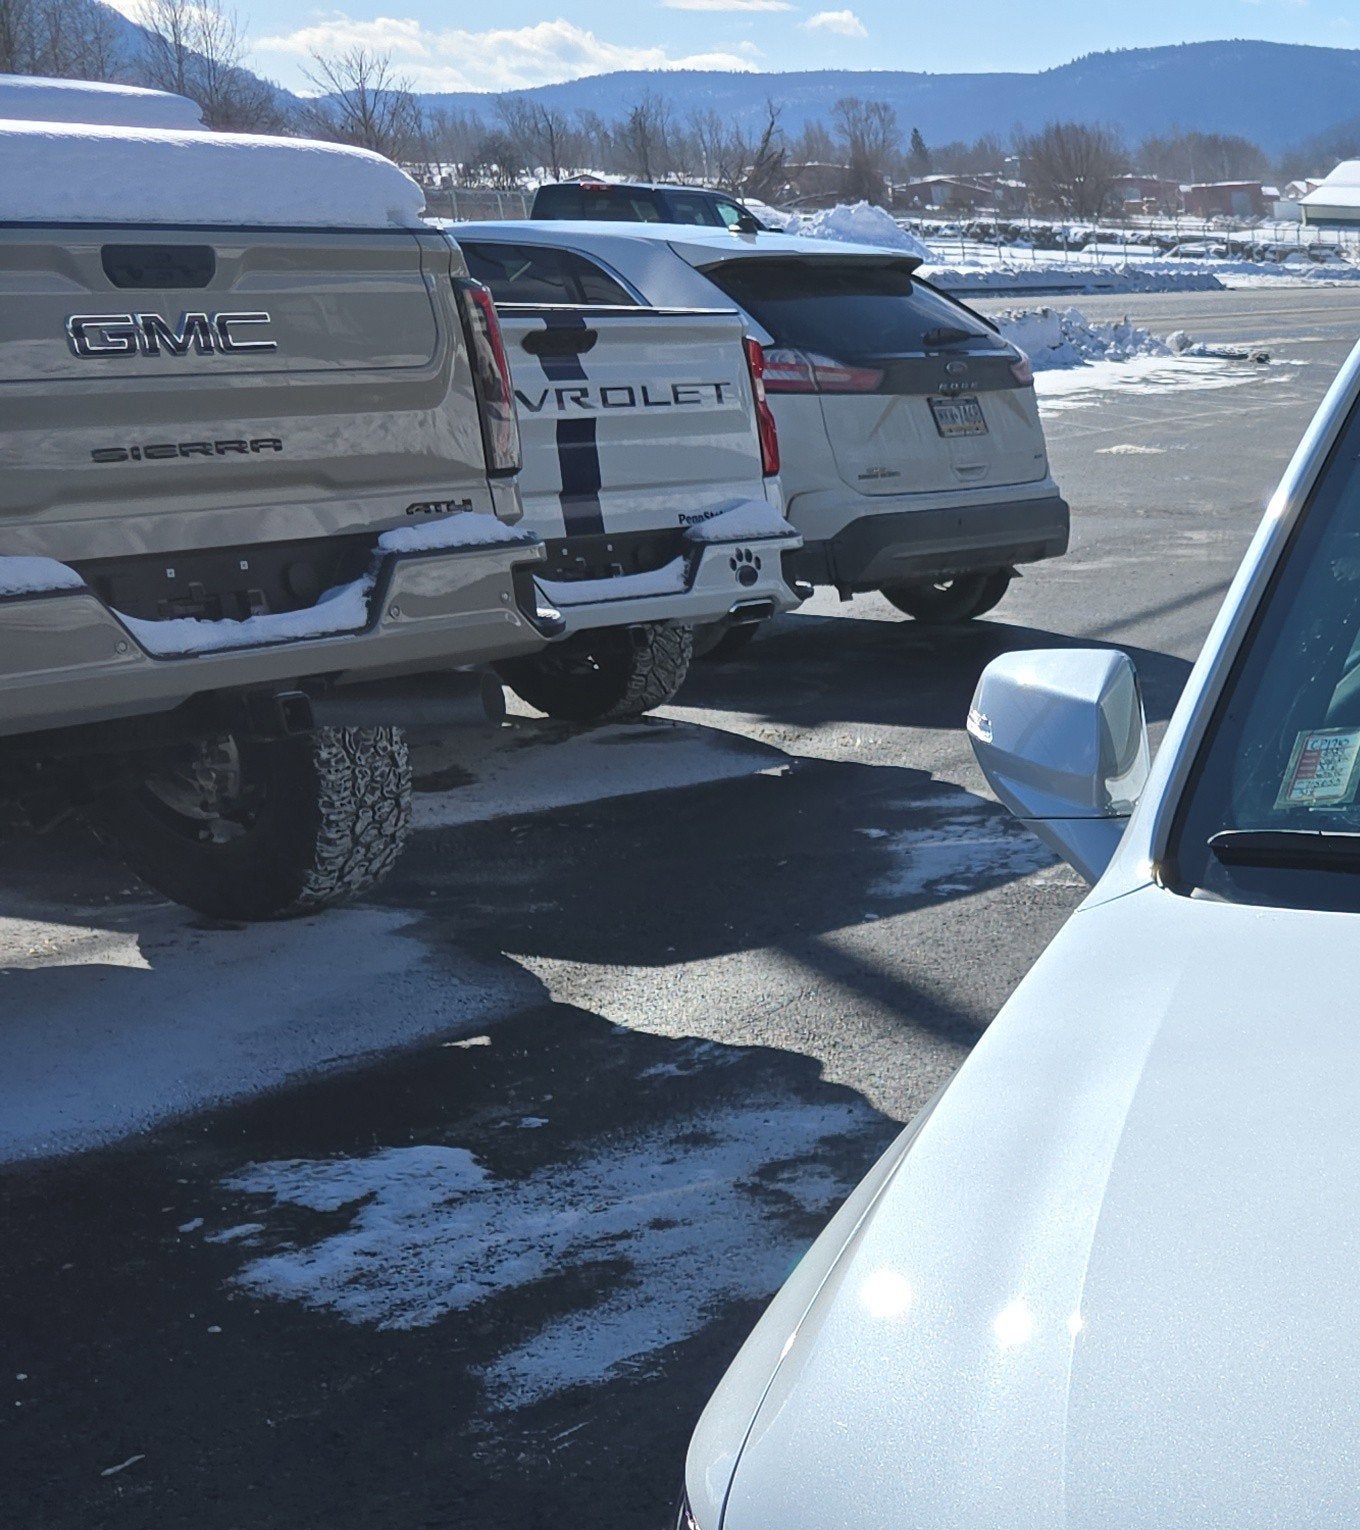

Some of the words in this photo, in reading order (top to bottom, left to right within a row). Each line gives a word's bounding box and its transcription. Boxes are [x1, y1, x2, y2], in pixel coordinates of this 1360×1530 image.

[65, 311, 277, 359] GMC
[514, 382, 731, 412] VROLET
[91, 438, 283, 464] SIERRA
